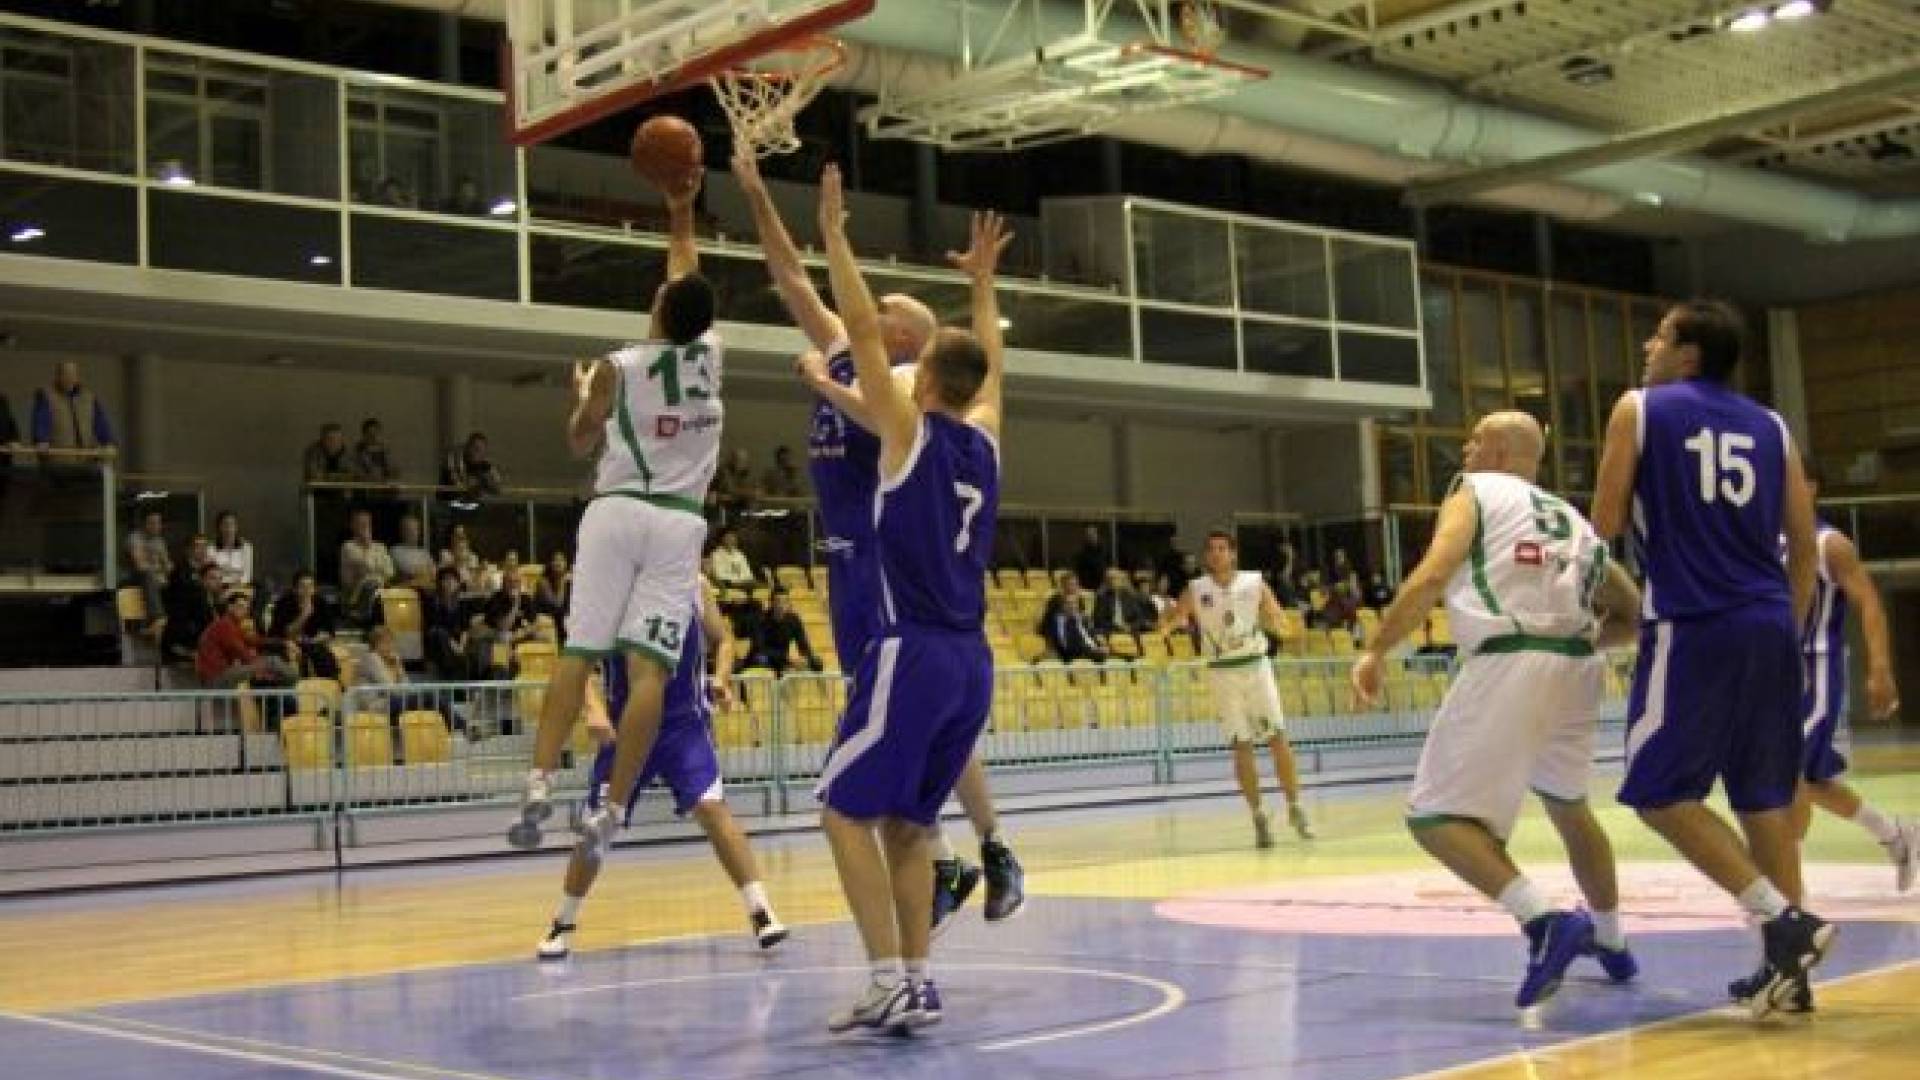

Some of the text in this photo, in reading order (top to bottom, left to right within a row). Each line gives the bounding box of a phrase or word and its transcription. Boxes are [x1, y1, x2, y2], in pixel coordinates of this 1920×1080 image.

[1684, 427, 1756, 507] 15
[954, 481, 984, 552] 7
[1529, 492, 1571, 540] 5
[645, 615, 680, 650] 13
